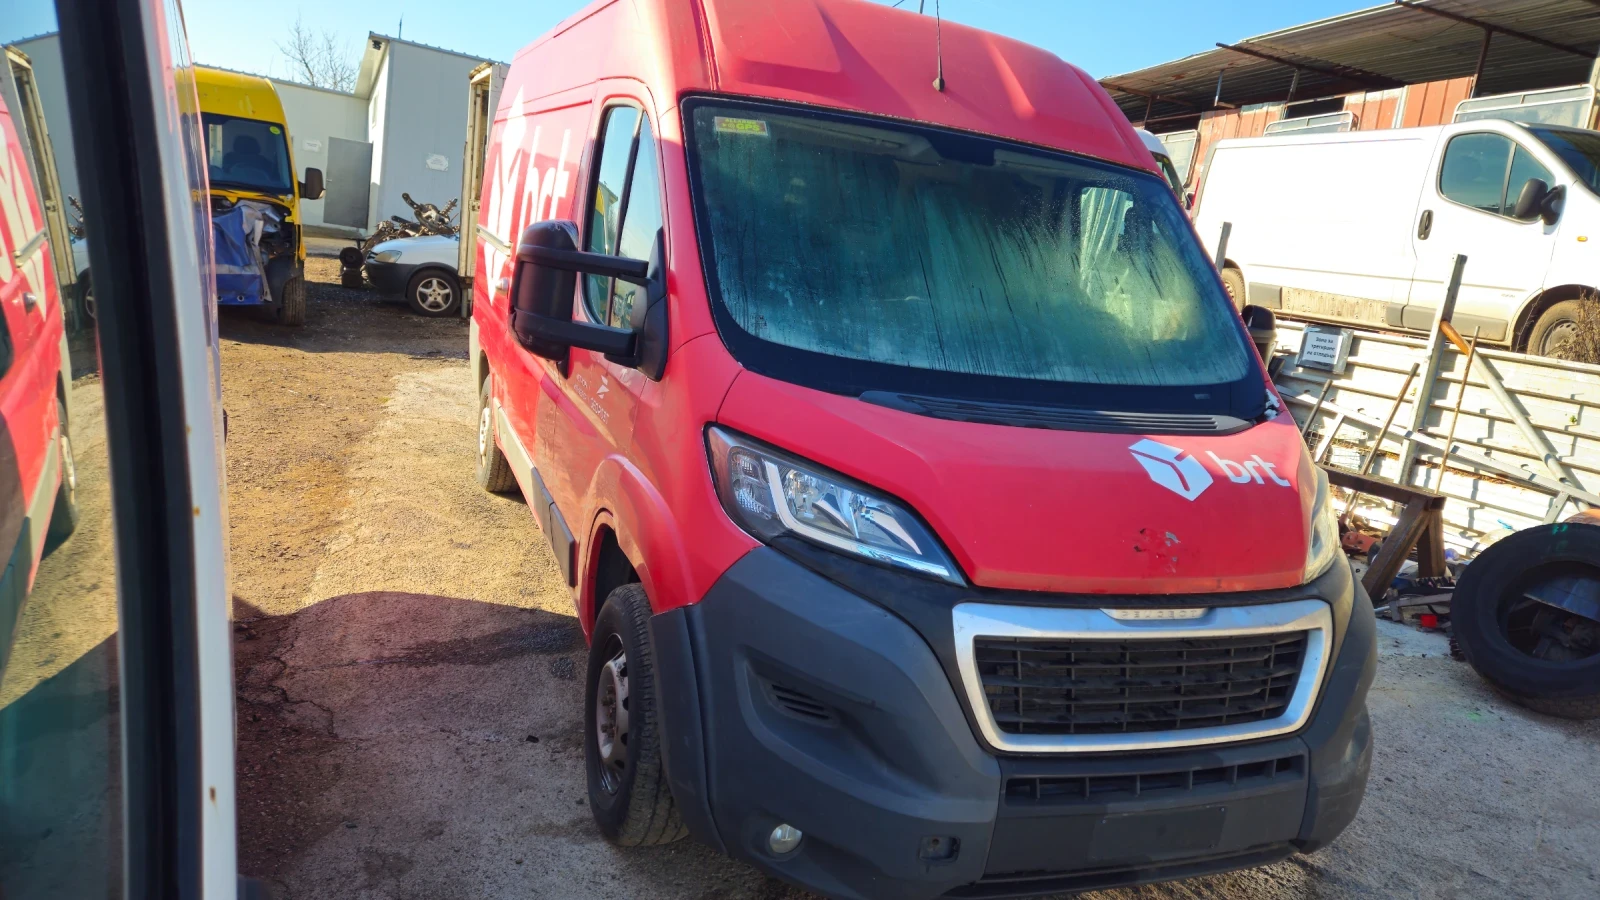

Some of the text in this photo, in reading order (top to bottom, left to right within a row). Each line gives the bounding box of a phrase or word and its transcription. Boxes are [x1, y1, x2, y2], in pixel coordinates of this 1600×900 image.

[736, 123, 760, 132] GPS
[516, 125, 571, 254] brt
[1205, 450, 1291, 487] brt
